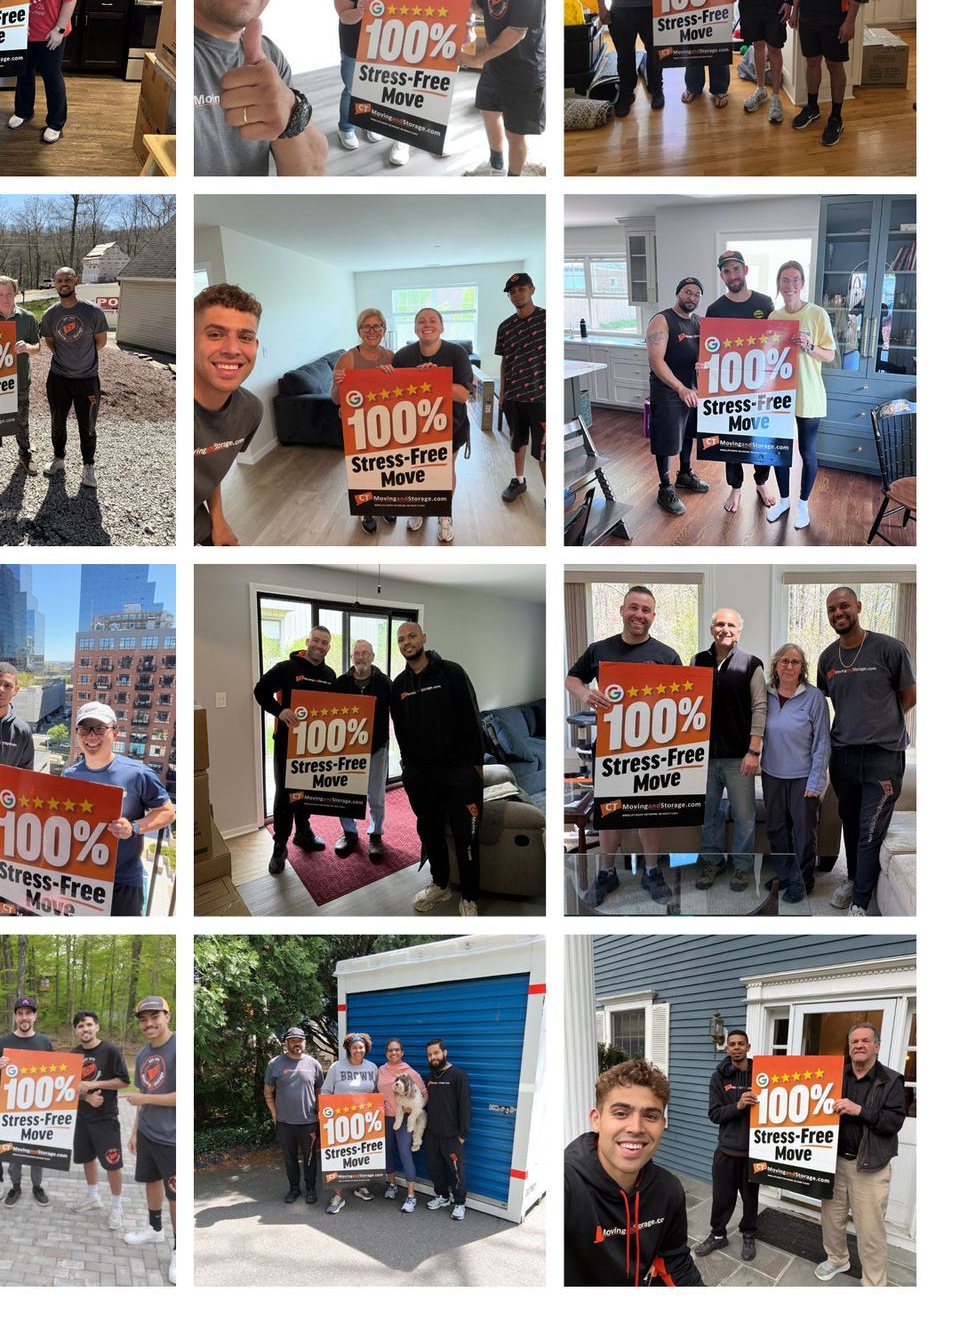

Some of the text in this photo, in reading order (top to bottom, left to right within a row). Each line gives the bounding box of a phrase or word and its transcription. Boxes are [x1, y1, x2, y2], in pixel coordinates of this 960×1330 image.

[658, 8, 729, 32] Stress-Free
[365, 18, 456, 64] 100%
[359, 65, 451, 91] Stress-Free
[703, 347, 793, 394] 100%
[703, 394, 791, 416] Stress-Free
[348, 397, 447, 450] 100%
[352, 446, 447, 473] Stress-Free
[381, 469, 425, 487] Move
[373, 495, 447, 503] MovingandStorage.com
[603, 695, 706, 751] 100%
[293, 717, 369, 755] 100%
[291, 757, 367, 774] Stress-Free
[602, 747, 705, 778] Stress-Free
[633, 771, 681, 794] Move
[605, 801, 701, 811] CT MovingandStorage.com
[0, 809, 109, 868] 100%
[340, 1070, 374, 1082] BROWN
[6, 1075, 76, 1110] 100%
[755, 1082, 834, 1125] 100%
[1, 1113, 72, 1128] Stress-Free
[323, 1109, 382, 1146] 100%
[754, 1128, 833, 1145] Stress-Free
[325, 1139, 384, 1161] Stress-Free
[775, 1145, 812, 1161] Move
[767, 1166, 830, 1184] MovingandStorage.com
